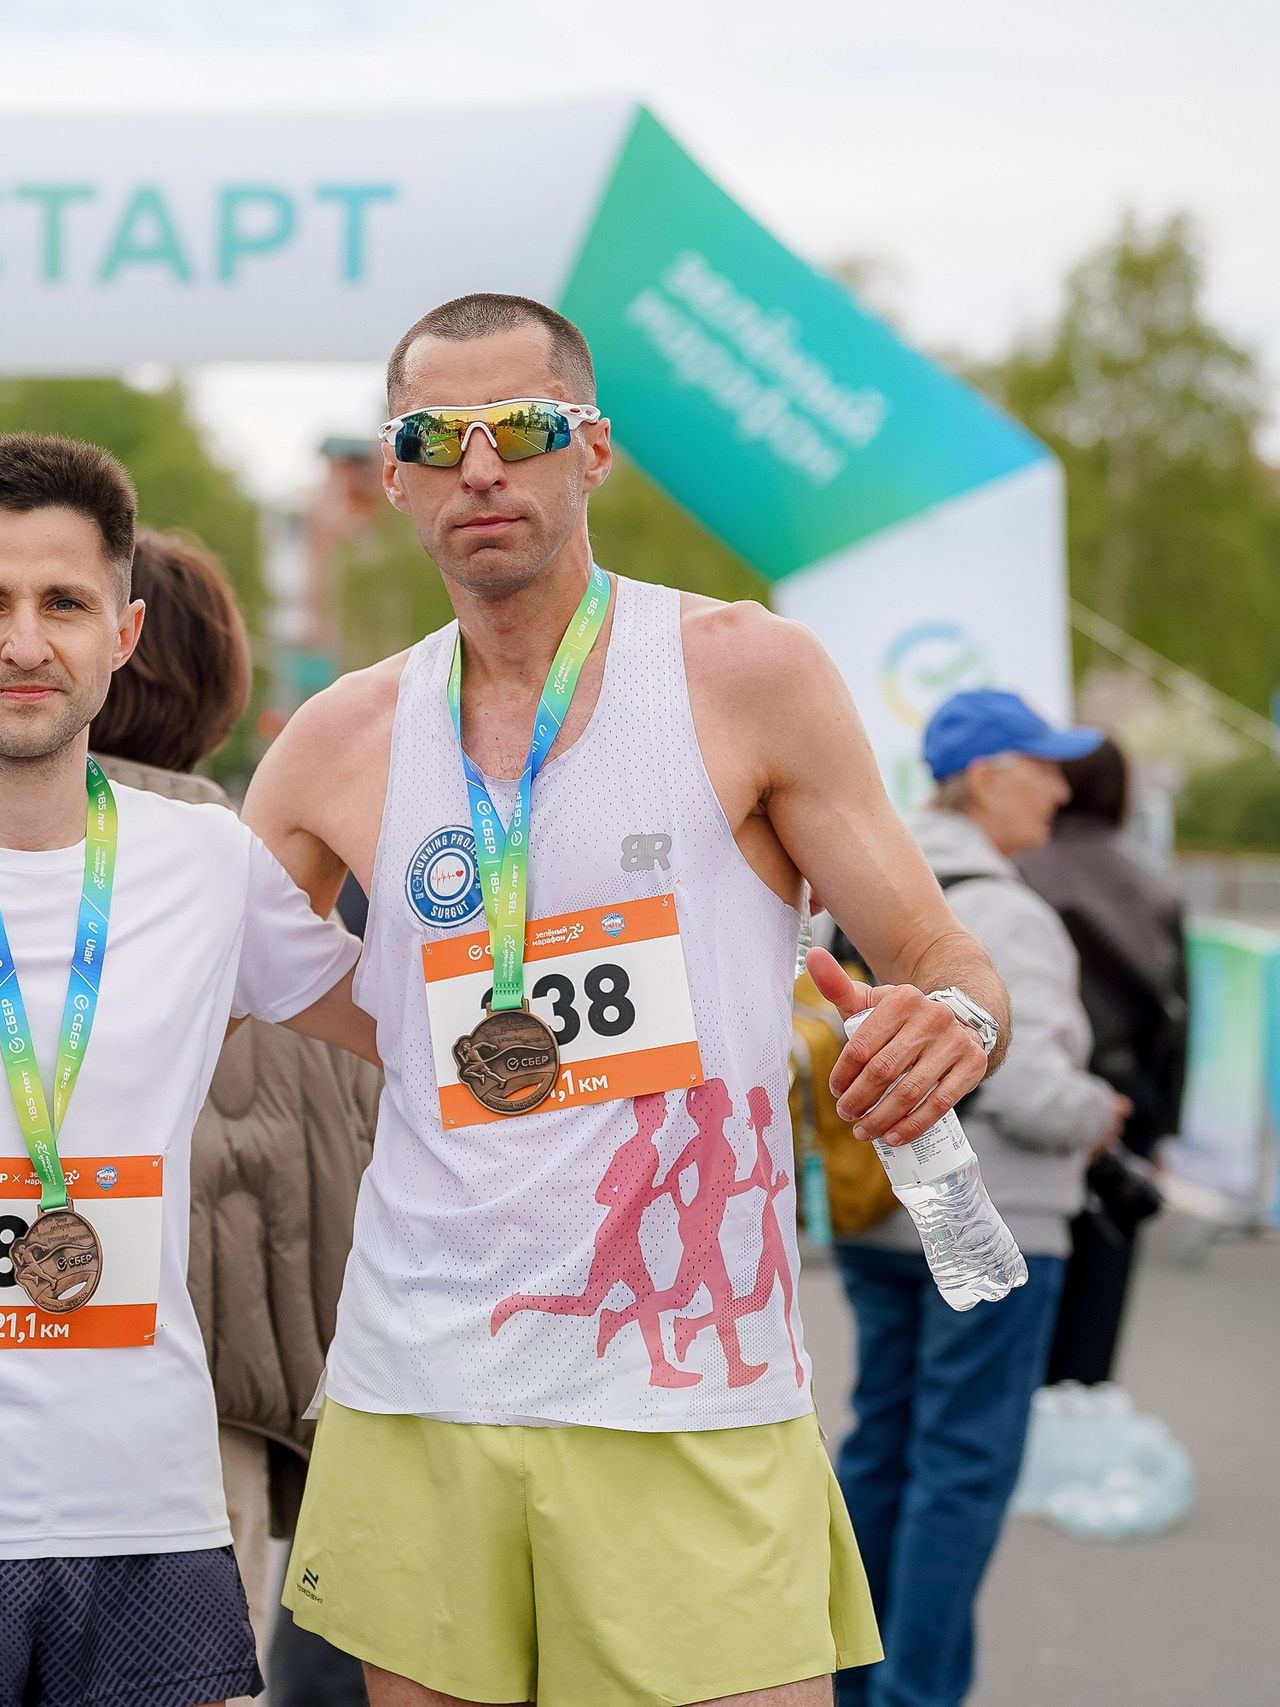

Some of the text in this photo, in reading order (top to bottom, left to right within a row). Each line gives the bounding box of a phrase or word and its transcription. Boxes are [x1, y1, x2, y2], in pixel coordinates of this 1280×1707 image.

[576, 596, 598, 638] 185 лет
[97, 791, 106, 832] 185 лет
[514, 792, 522, 827] СБЕР
[482, 819, 496, 854] СБЕР
[414, 833, 478, 876] RUNNING PROJE
[490, 871, 500, 894] 185
[431, 900, 469, 919] SURGUT
[508, 892, 517, 914] 185
[532, 935, 566, 947] марафон
[535, 926, 568, 940] зелёный
[83, 938, 96, 965] Utair
[1, 998, 19, 1035] СБЕР
[481, 963, 636, 1046] 38
[69, 1013, 83, 1050] СБЕР
[521, 1055, 549, 1067] СБЕР
[60, 1066, 72, 1089] 185
[21, 1070, 38, 1121] 185 лет
[69, 1254, 93, 1267] СБЕР
